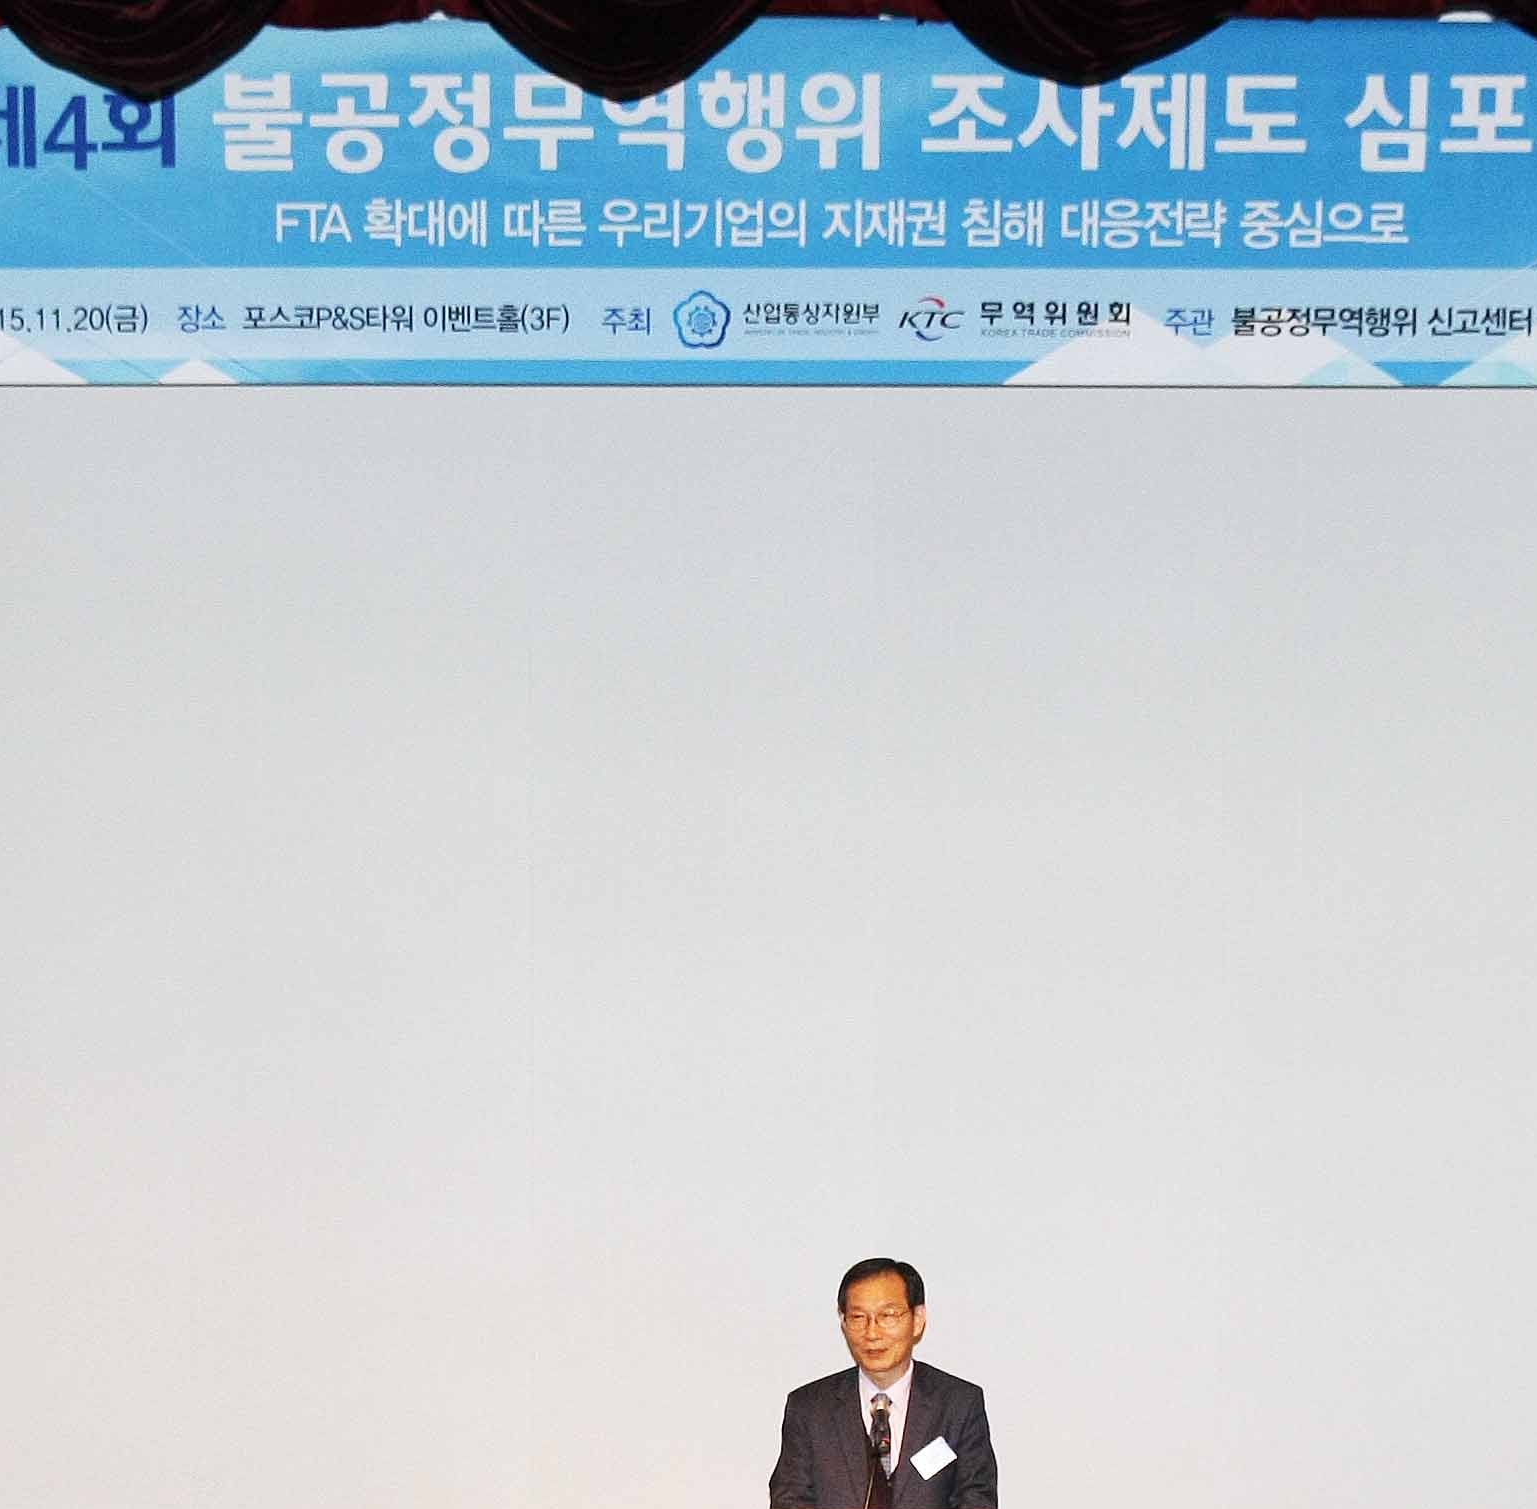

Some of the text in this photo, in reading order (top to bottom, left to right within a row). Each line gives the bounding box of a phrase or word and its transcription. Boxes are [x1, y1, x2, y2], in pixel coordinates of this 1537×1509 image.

[212, 70, 881, 174] 불공정무역행위
[921, 74, 1306, 171] 조사제도
[276, 198, 1408, 249] FTA 확대에 따른 우리기업의 지재권 침해 대응전략 중심으로
[177, 303, 570, 335] 장소 포스코P&S타워 이벤트홀(3F)
[601, 307, 651, 336] 주최
[742, 302, 880, 326] 산업통상자원부
[898, 310, 965, 330] KTC
[1165, 305, 1533, 338] 주관 불공정무역행위 신고센터
